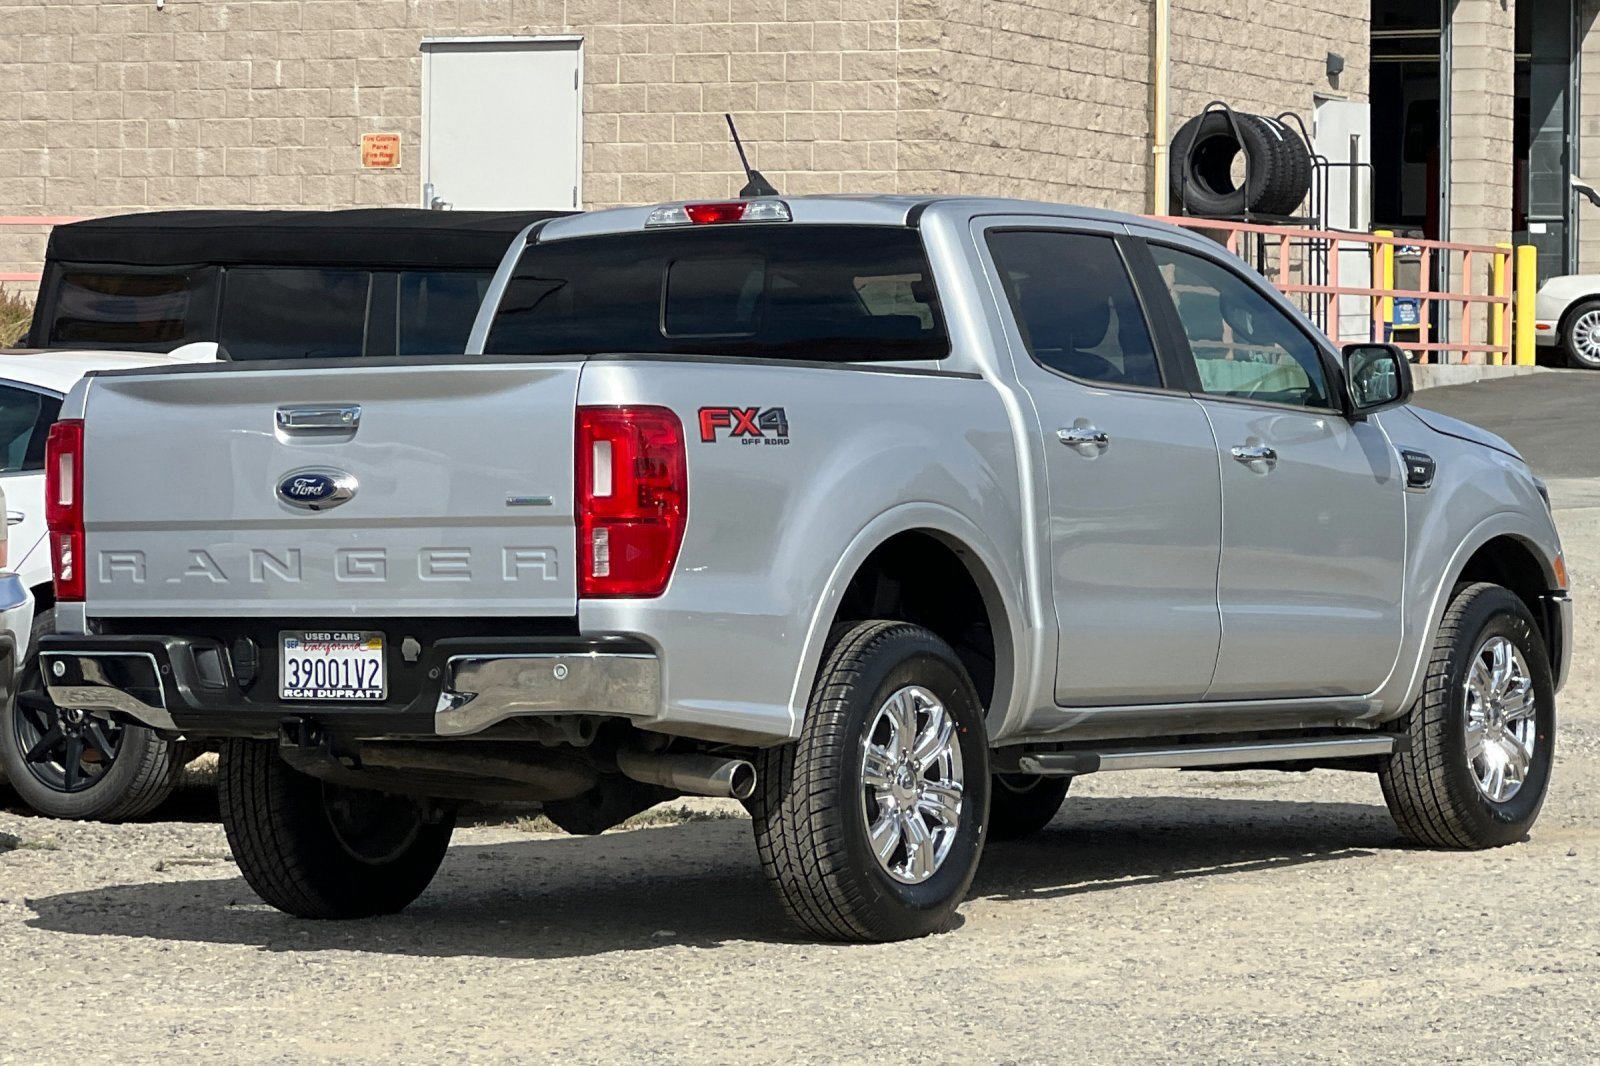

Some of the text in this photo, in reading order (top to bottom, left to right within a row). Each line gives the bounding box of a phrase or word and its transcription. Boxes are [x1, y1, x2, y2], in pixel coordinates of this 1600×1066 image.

[697, 406, 788, 443] FX4
[764, 438, 790, 446] ROAD
[290, 478, 324, 496] Ford
[99, 546, 559, 584] RANGER
[333, 633, 360, 641] CARS
[302, 640, 369, 656] California
[288, 658, 380, 689] 39001V2
[317, 690, 382, 698] DUPRATT
